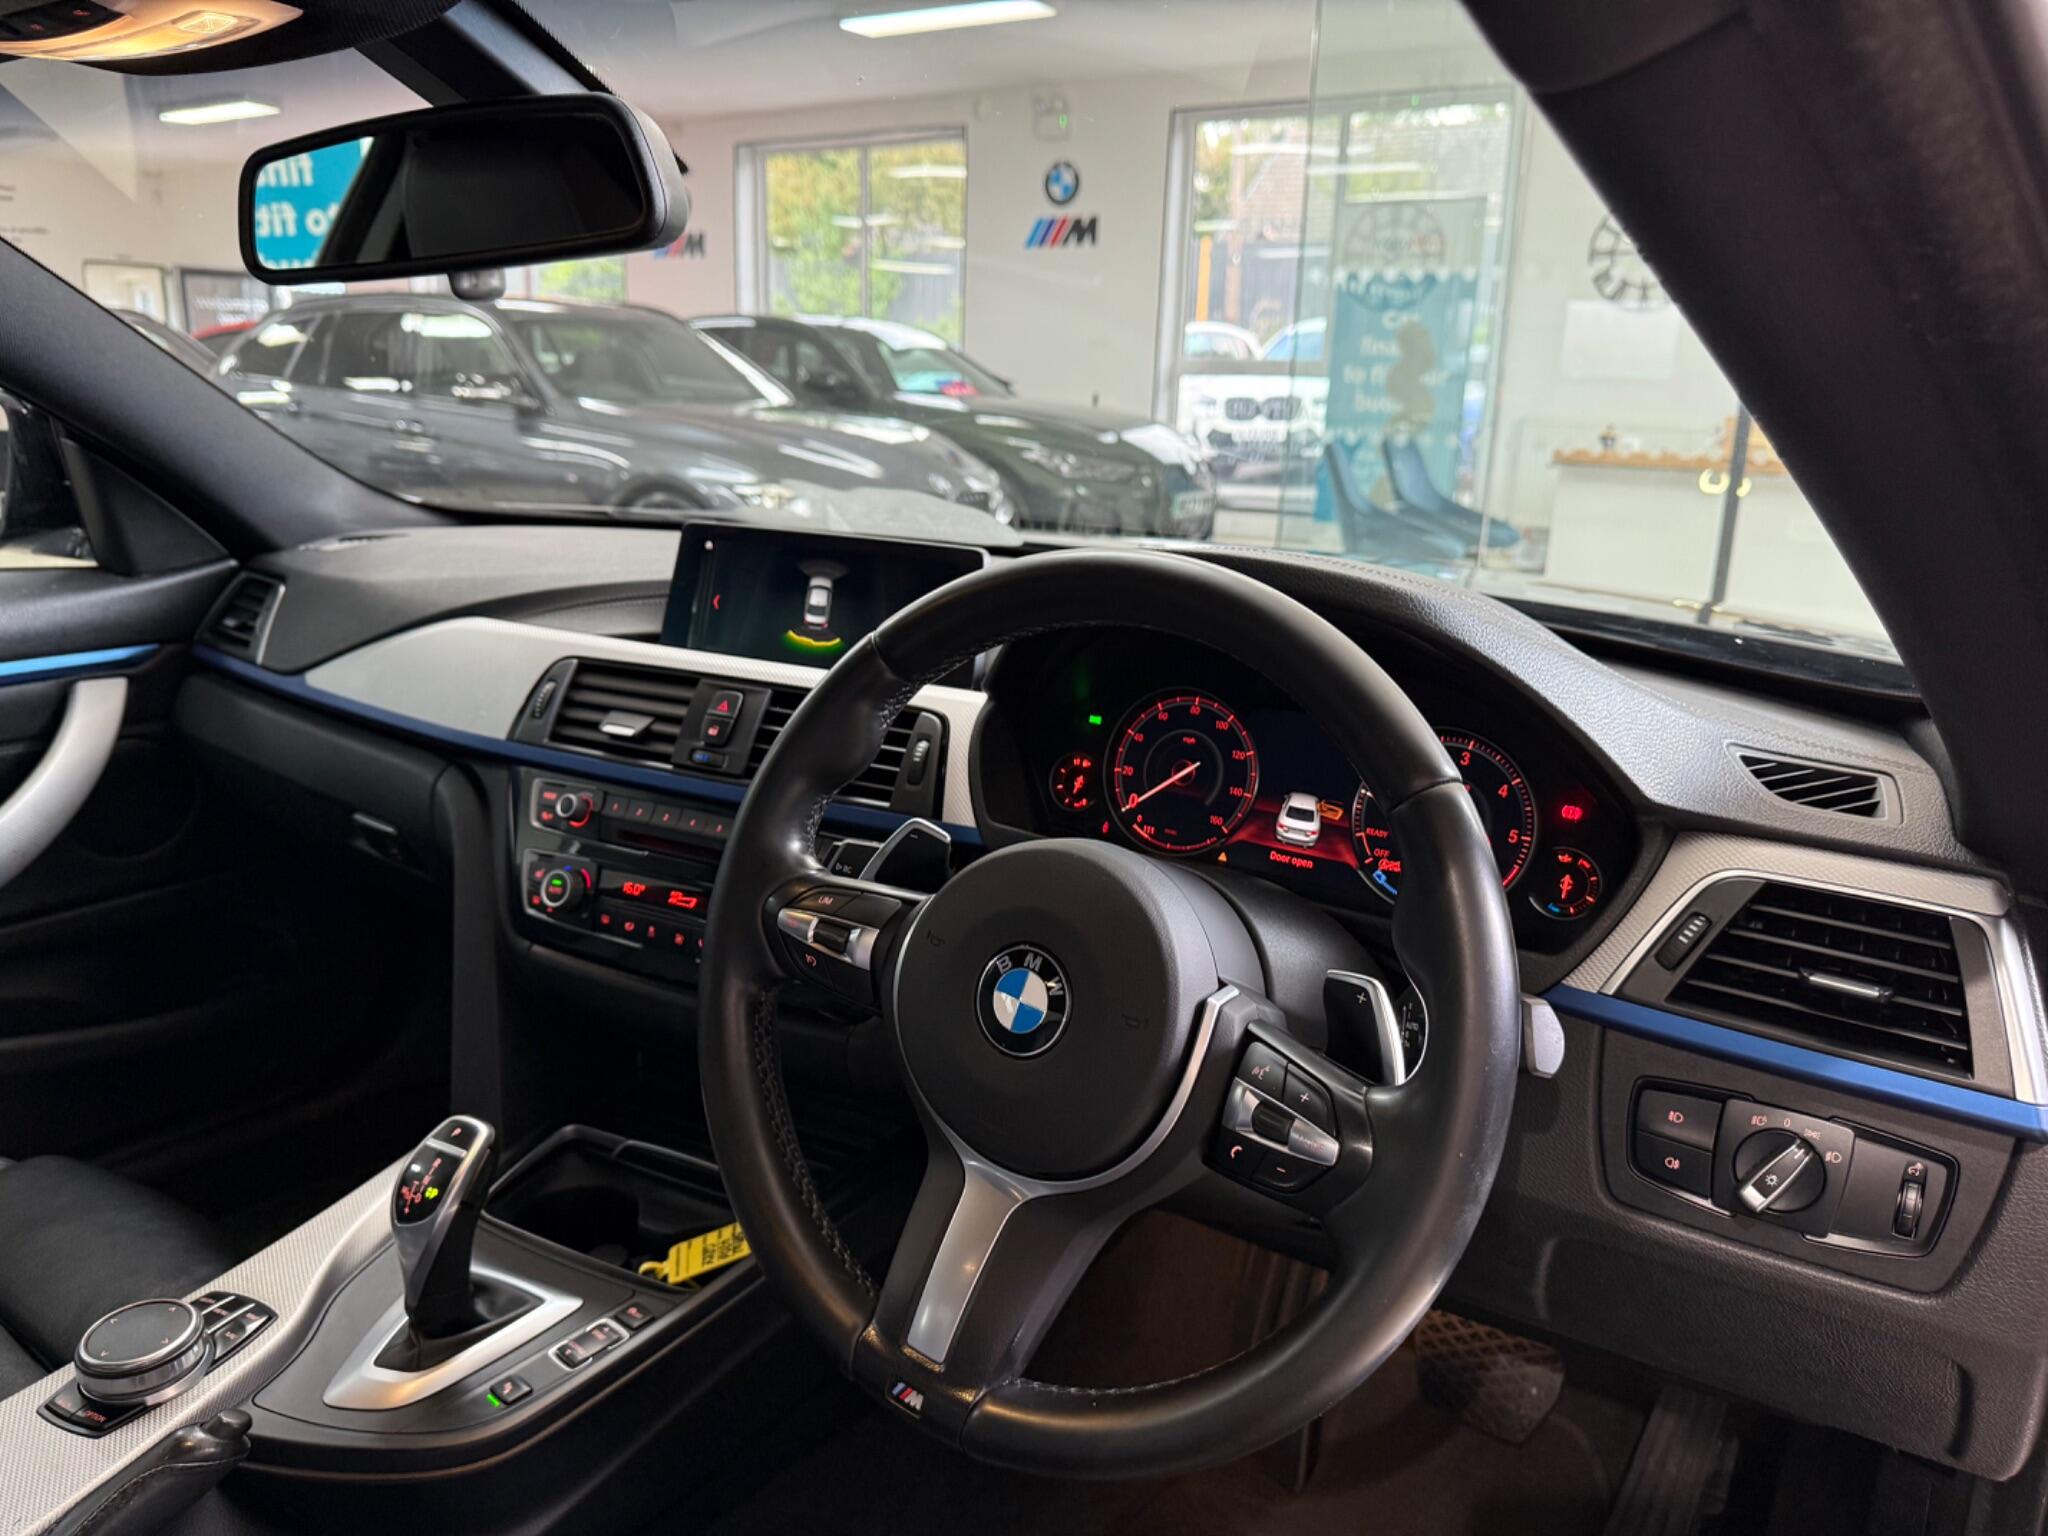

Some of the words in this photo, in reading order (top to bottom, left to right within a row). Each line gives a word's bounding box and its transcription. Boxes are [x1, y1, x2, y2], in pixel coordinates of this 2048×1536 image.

[1190, 705, 1201, 716] 80
[1158, 711, 1169, 722] 60
[1215, 720, 1229, 731] 100
[1133, 734, 1144, 743] 40
[1232, 750, 1246, 761] 120
[1459, 751, 1471, 766] 3
[1122, 765, 1134, 776] 20
[1229, 786, 1244, 797] 140
[1497, 783, 1509, 799] 4
[1507, 828, 1520, 844] 5
[1373, 848, 1391, 858] OFF
[1269, 850, 1290, 865] Door
[1291, 857, 1314, 869] open
[996, 951, 1065, 997] BMW
